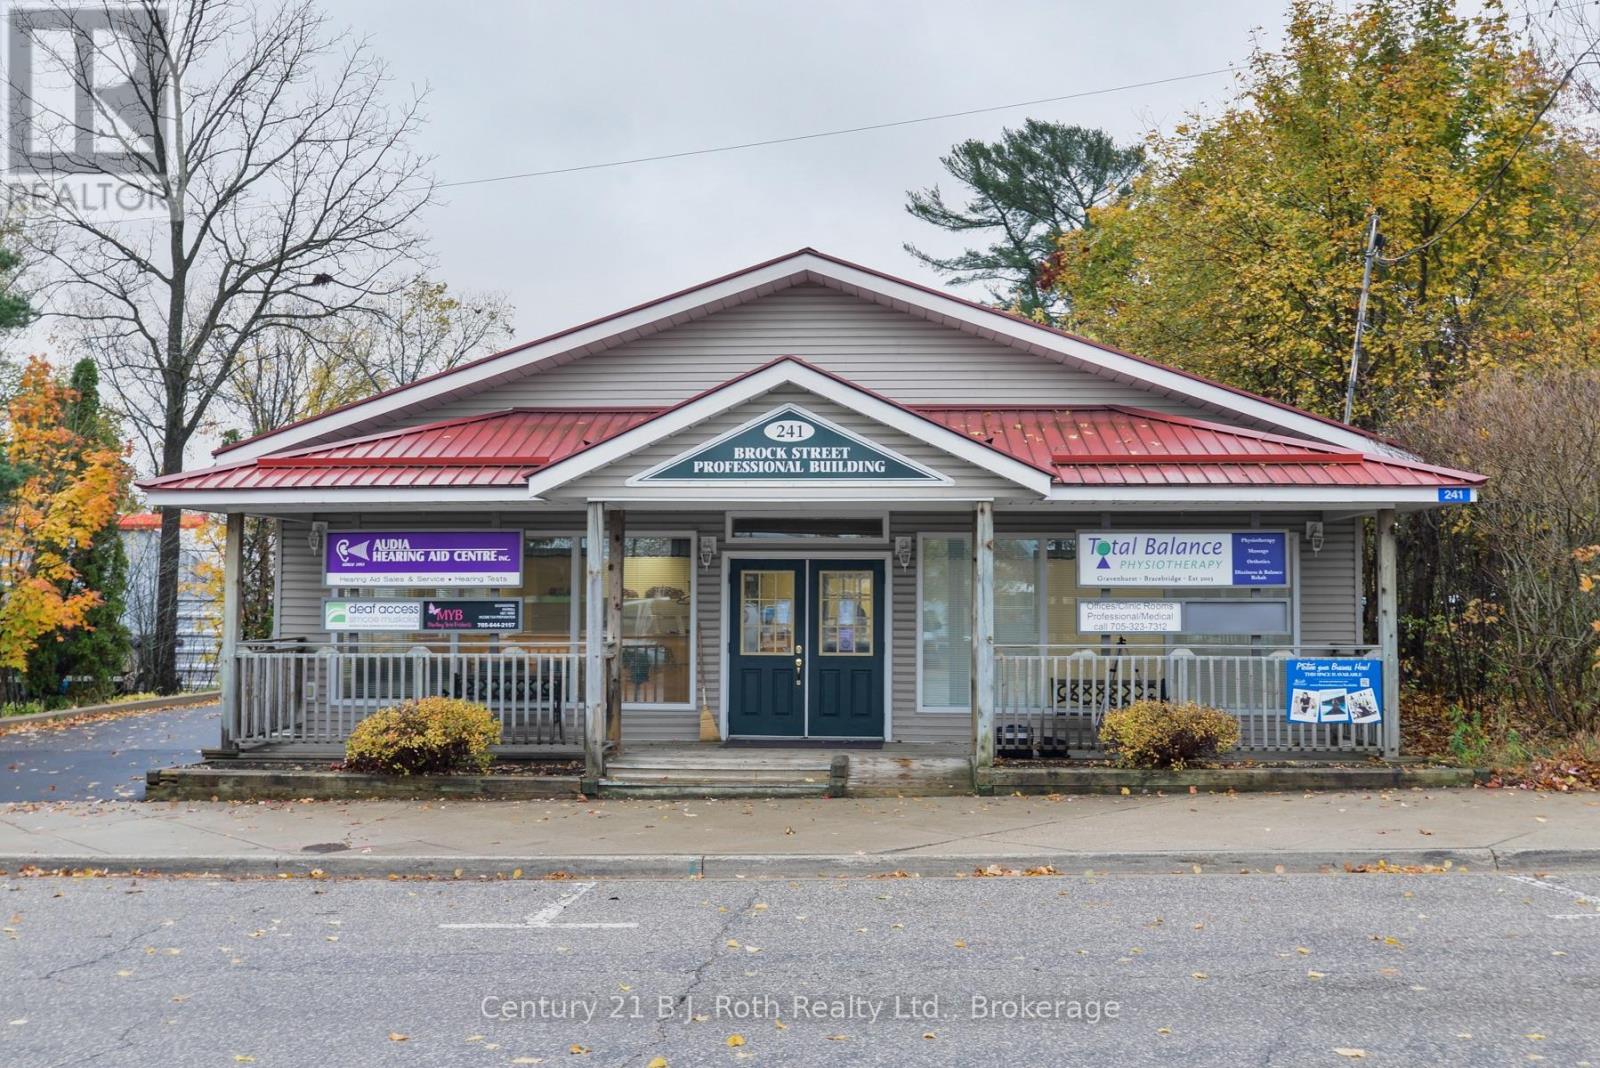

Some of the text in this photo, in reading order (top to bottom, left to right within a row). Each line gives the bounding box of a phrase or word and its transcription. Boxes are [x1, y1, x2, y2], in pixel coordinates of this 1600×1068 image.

[776, 424, 804, 438] 241
[734, 447, 851, 459] BROCK STREET
[693, 460, 886, 473] PROFESSIONAL BUILDING
[1444, 489, 1464, 500] 241
[373, 539, 411, 550] AUDIA
[1088, 536, 1138, 556] Total
[1144, 536, 1223, 555] Balance
[372, 550, 425, 562] HEARING
[427, 550, 450, 562] AID
[453, 550, 498, 562] CENTRE
[1119, 559, 1223, 570] PHYSIOTHERAPY
[1143, 575, 1182, 583] Bracebridge
[348, 603, 419, 614] deaf access
[1144, 602, 1174, 610] Rooms
[436, 609, 464, 621] MYB
[1087, 612, 1174, 621] Professional/Medical
[1093, 622, 1168, 631] call 705-323-7312
